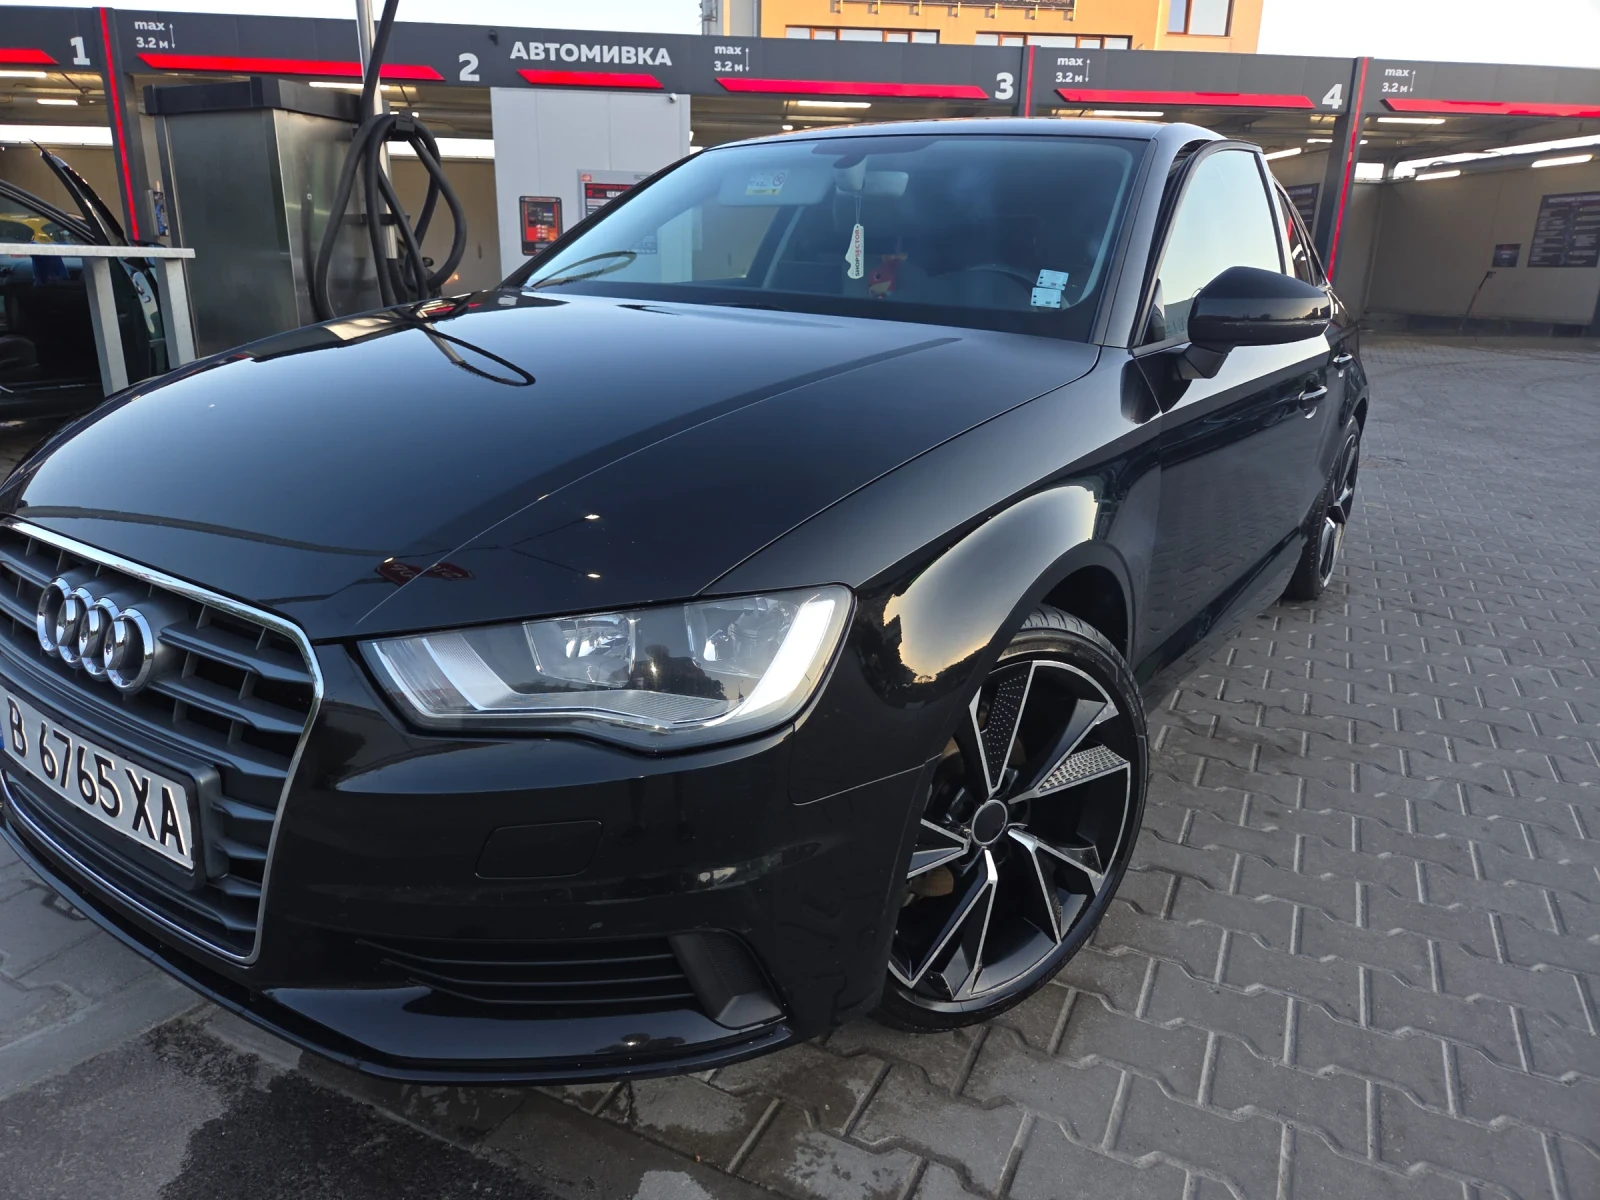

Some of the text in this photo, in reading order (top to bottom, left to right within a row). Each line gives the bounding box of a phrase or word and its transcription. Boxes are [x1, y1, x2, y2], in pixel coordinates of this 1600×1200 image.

[134, 21, 165, 31] max
[136, 36, 157, 49] 3.2
[70, 36, 91, 66] 1
[509, 41, 673, 66] АВТОМИВКА
[714, 46, 742, 55] max
[458, 53, 480, 82] 2
[713, 60, 733, 72] 3.2
[1057, 57, 1084, 66] max
[1055, 71, 1074, 83] 3.2
[1384, 68, 1410, 77] max
[994, 71, 1014, 100] 3
[1381, 82, 1399, 93] 3.2
[1321, 83, 1343, 110] 4
[7, 695, 29, 758] B
[38, 719, 123, 818] 6765
